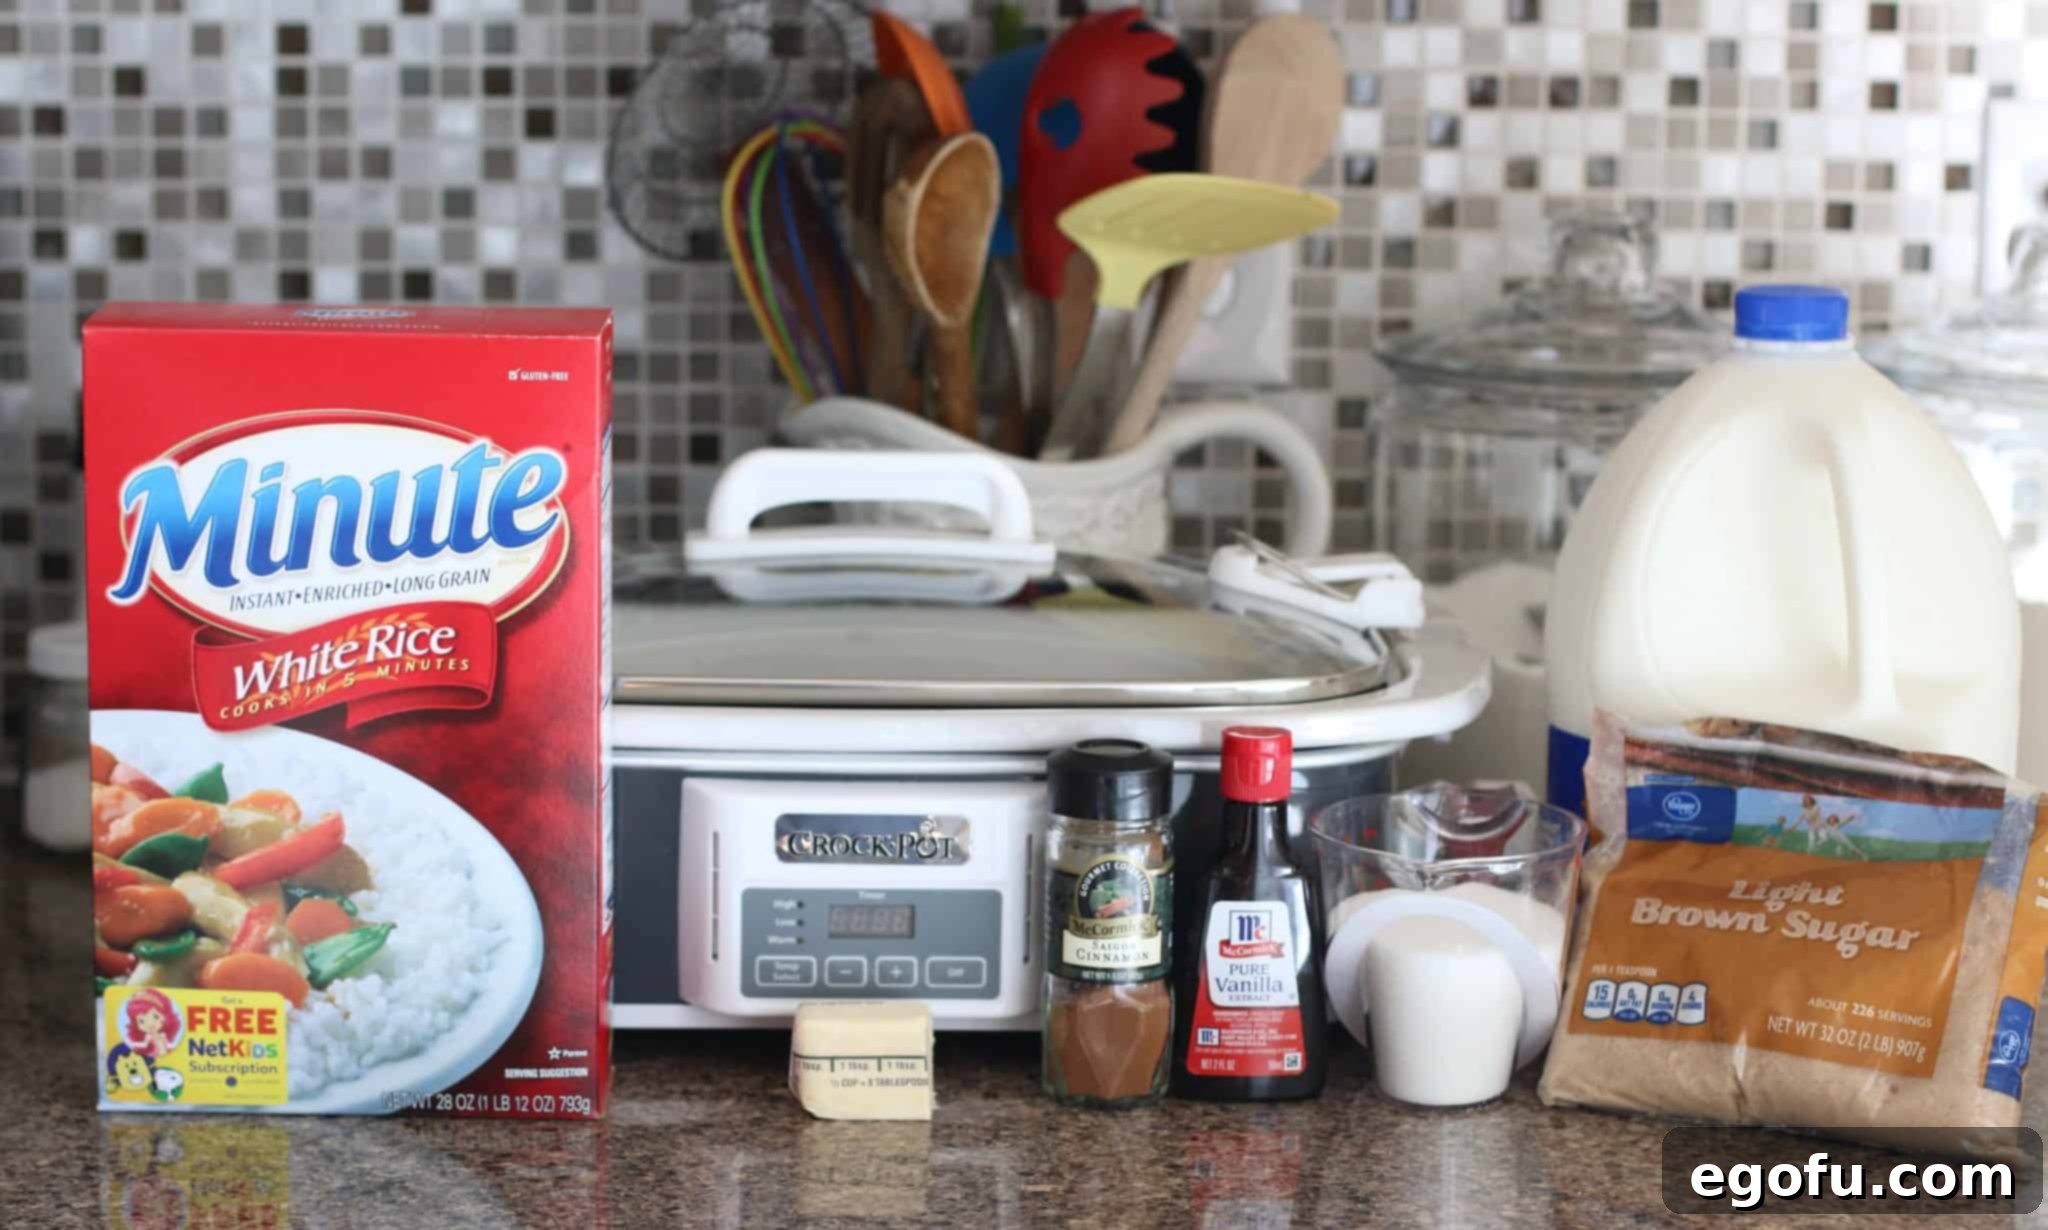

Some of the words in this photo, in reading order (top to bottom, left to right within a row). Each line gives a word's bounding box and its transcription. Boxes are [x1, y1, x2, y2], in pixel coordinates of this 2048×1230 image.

[520, 371, 569, 381] GLUTEN-FREE
[106, 440, 567, 606] Minute
[438, 568, 491, 591] GRAIN
[233, 640, 359, 700] White
[365, 622, 455, 664] Rice
[220, 694, 290, 719] COOKS
[304, 682, 326, 698] IN
[344, 674, 355, 687] 5
[376, 658, 470, 678] MINUTES
[1080, 862, 1111, 897] GOURMET
[859, 891, 886, 899] Timer
[1728, 880, 1844, 912] Light
[773, 900, 796, 909] High
[775, 918, 796, 926] Low
[1631, 896, 1770, 933] Brown
[1781, 909, 1920, 959] Sugar
[768, 936, 796, 944] Warm
[774, 961, 799, 971] Temp
[1229, 964, 1270, 975] PURE
[1617, 964, 1657, 976] TEASPOON
[773, 972, 800, 981] Select
[1215, 976, 1284, 993] Vanilla
[1594, 984, 1609, 1000] 15
[1807, 997, 1848, 1012] ABOUT
[1852, 1002, 1874, 1017] 226
[1877, 1008, 1932, 1027] SERVINGS
[187, 1006, 278, 1035] FREE
[1767, 1015, 1792, 1034] NET
[1795, 1020, 1818, 1038] WT
[1819, 1024, 1835, 1042] 32
[1836, 1028, 1857, 1047] OZ
[1858, 1030, 1871, 1051] (2
[1873, 1035, 1894, 1056] LB)
[1896, 1038, 1926, 1063] 907g
[189, 1061, 278, 1075] Subscription
[505, 1068, 538, 1078] SERVING
[540, 1067, 588, 1078] SUGGESTION
[842, 1079, 858, 1087] CUP
[412, 1094, 432, 1109] WT
[436, 1094, 453, 1110] 28
[456, 1094, 475, 1111] OZ
[478, 1095, 489, 1112] (1
[493, 1095, 510, 1111] LB
[515, 1096, 529, 1112] 12
[533, 1095, 556, 1112] OZ)
[559, 1096, 591, 1115] 793g
